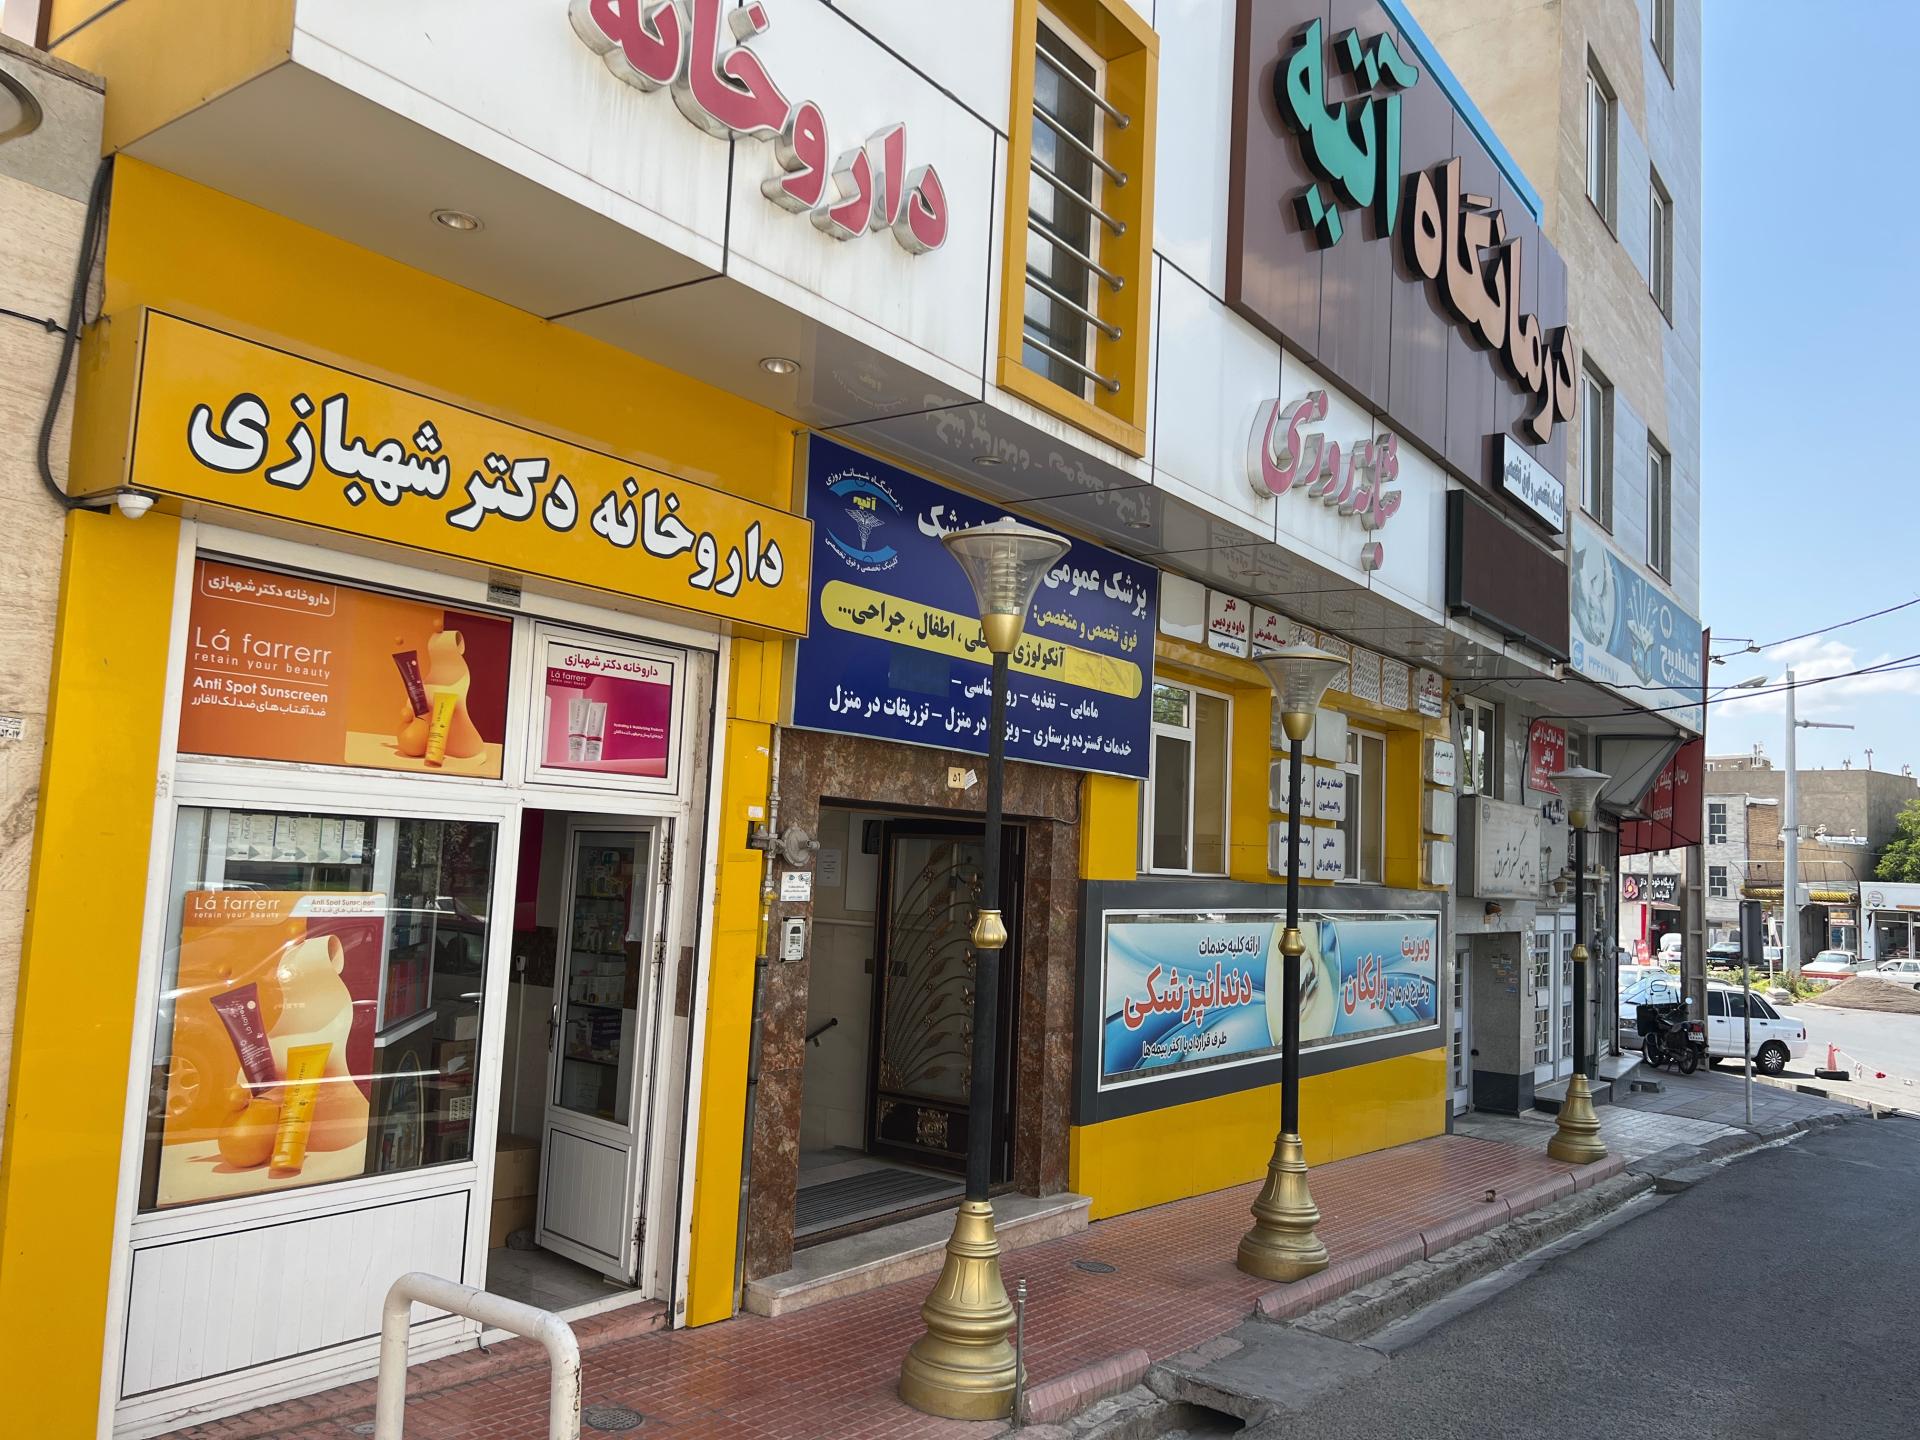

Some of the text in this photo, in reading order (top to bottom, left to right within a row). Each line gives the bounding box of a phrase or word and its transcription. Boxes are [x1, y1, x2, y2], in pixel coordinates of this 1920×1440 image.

[1275, 17, 1576, 445] درمانگاه آتیه
[1247, 389, 1356, 506] روزی
[843, 468, 870, 481] شبانه
[188, 392, 785, 598] داروخانه دکتر شهبازی
[853, 496, 877, 511] آتیه
[208, 576, 331, 607] داروخانه دکتر شهبازی
[1043, 563, 1147, 620] پزشک عمومی
[1079, 622, 1086, 639] و
[1087, 623, 1120, 642] تخصص
[1120, 630, 1138, 652] فوق
[195, 626, 332, 665] Lá farrerr
[1012, 641, 1066, 670] آنکولوژی
[194, 652, 331, 680] retain your beauty
[564, 653, 658, 678] داروخانه دکتر شهبازی
[193, 676, 328, 703] Anti Spot Sunscreen
[829, 684, 862, 714] منزل
[1031, 690, 1056, 711] تغذیه
[864, 696, 881, 718] در
[883, 696, 930, 727] تزریقات
[945, 706, 972, 733] منزل
[1070, 699, 1099, 720] مامایی
[973, 716, 987, 736] در
[1033, 725, 1070, 752] پرستاری
[1072, 734, 1103, 754] گسترده
[1103, 737, 1132, 756] خدمات
[223, 896, 280, 910] farrerr
[1199, 935, 1261, 957] ارائه کلیه خدمات
[1401, 935, 1430, 962] ویزیت
[1124, 962, 1253, 1031] دندانپزشکی
[1344, 954, 1388, 1015] رایگان
[1211, 1032, 1227, 1048] طرف
